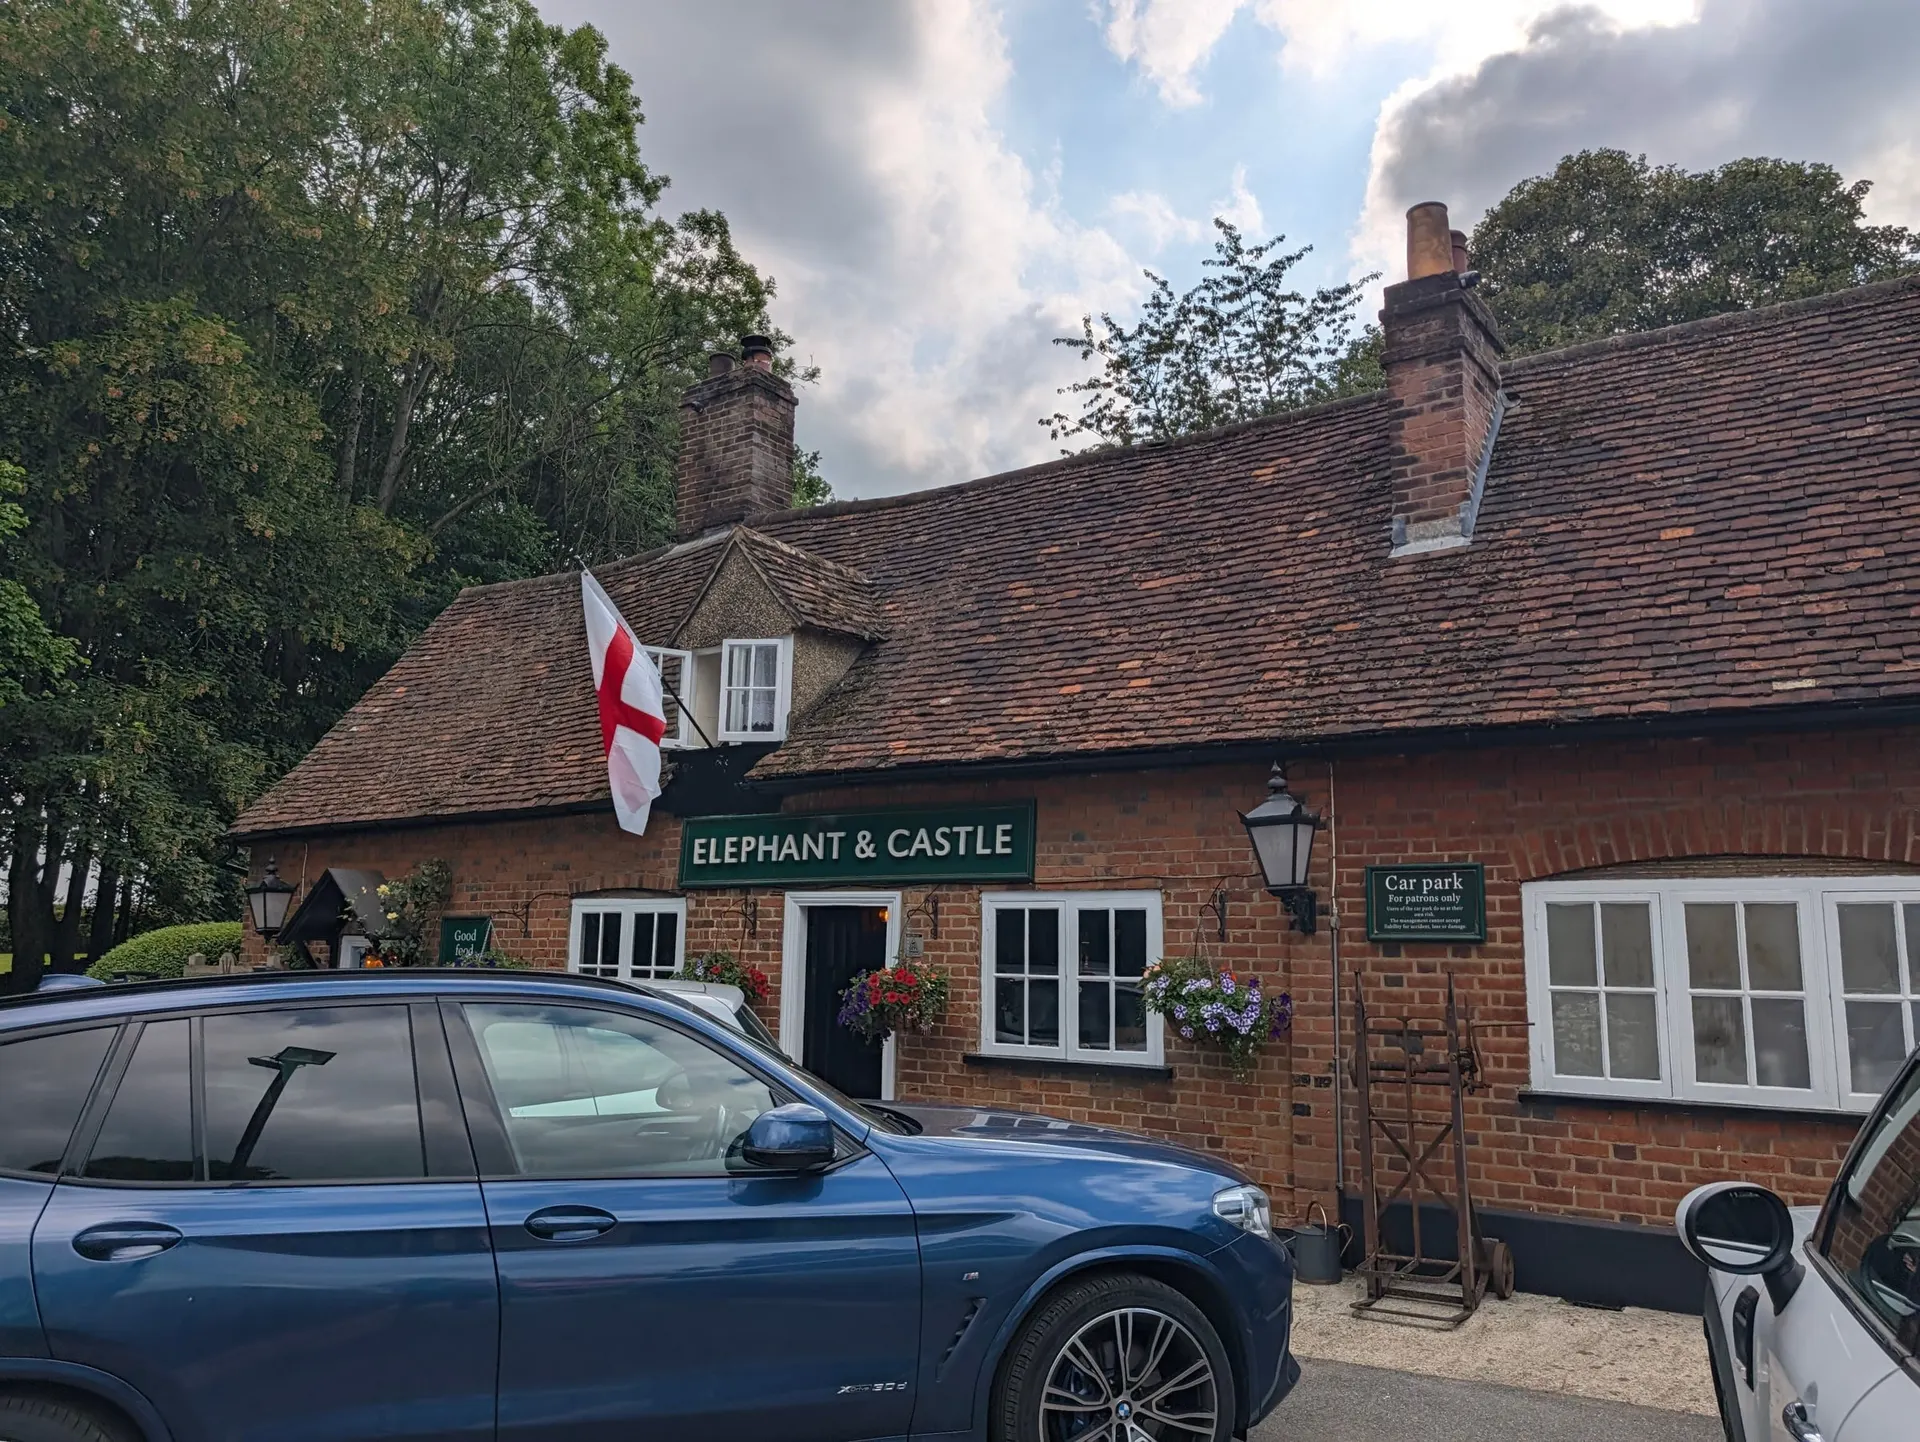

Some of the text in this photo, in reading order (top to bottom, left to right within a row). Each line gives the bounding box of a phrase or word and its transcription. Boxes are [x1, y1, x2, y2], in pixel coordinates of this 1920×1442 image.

[692, 824, 1013, 865] ELEPHANT & CASTLE
[1385, 872, 1464, 894] Car park
[1388, 892, 1461, 905] For patrons only
[454, 929, 477, 941] Good
[455, 943, 474, 955] food
